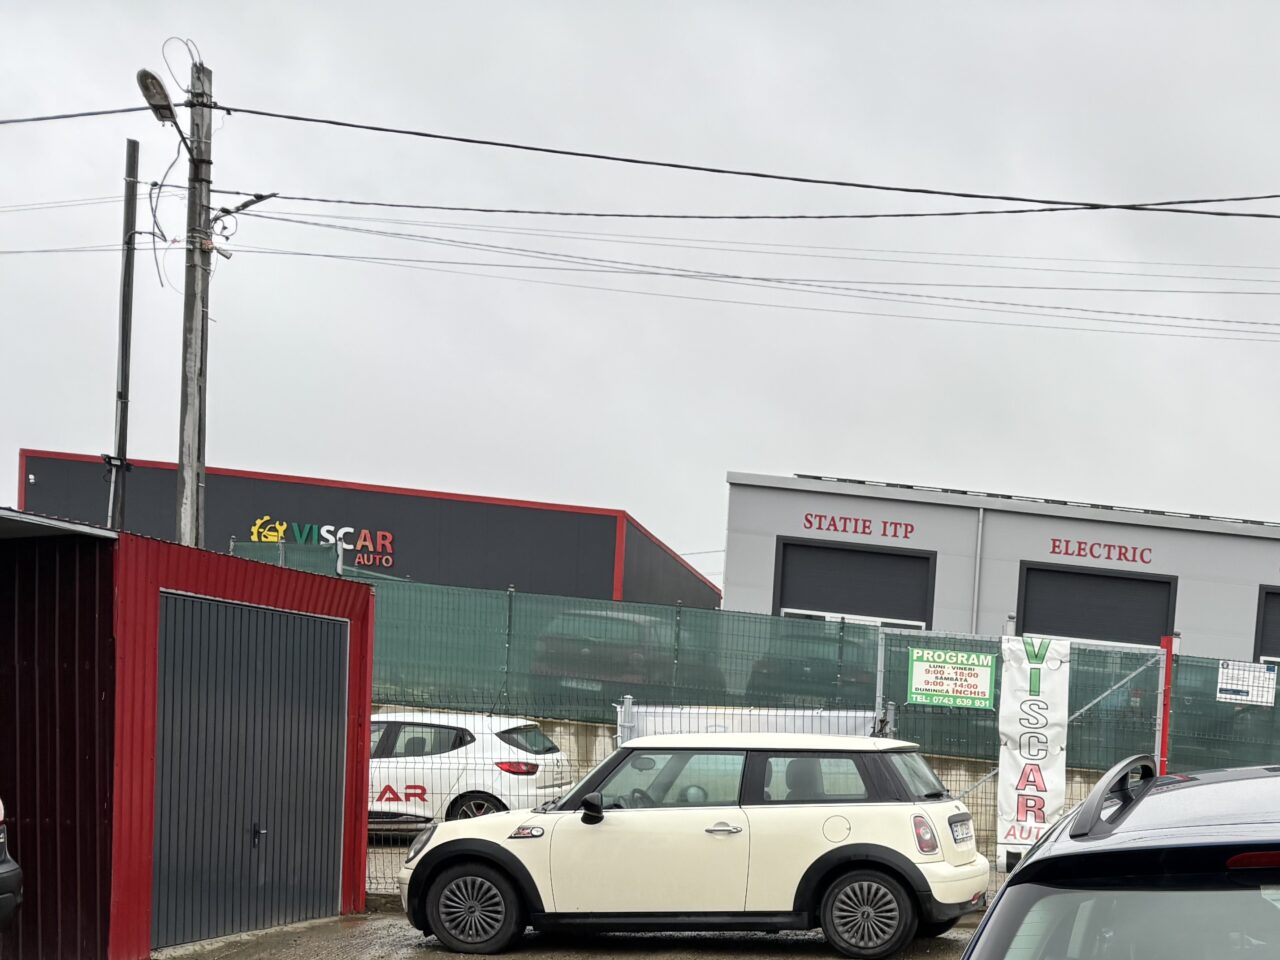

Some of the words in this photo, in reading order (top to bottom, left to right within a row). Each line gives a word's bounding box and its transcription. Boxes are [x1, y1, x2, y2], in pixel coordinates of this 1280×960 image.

[803, 513, 872, 535] STATIE
[881, 521, 914, 539] ITP
[291, 521, 393, 553] VISCAR
[1049, 538, 1152, 564] ELECTRIC
[355, 553, 393, 567] AUTO
[913, 649, 992, 666] PROGRAM
[924, 668, 945, 676] 9:00
[911, 694, 930, 702] TEL:
[933, 696, 954, 704] 0743
[952, 687, 986, 697] ÎNCHIS
[1016, 637, 1050, 823] VISCAR
[371, 784, 428, 802] AR
[1004, 825, 1044, 840] AUT
